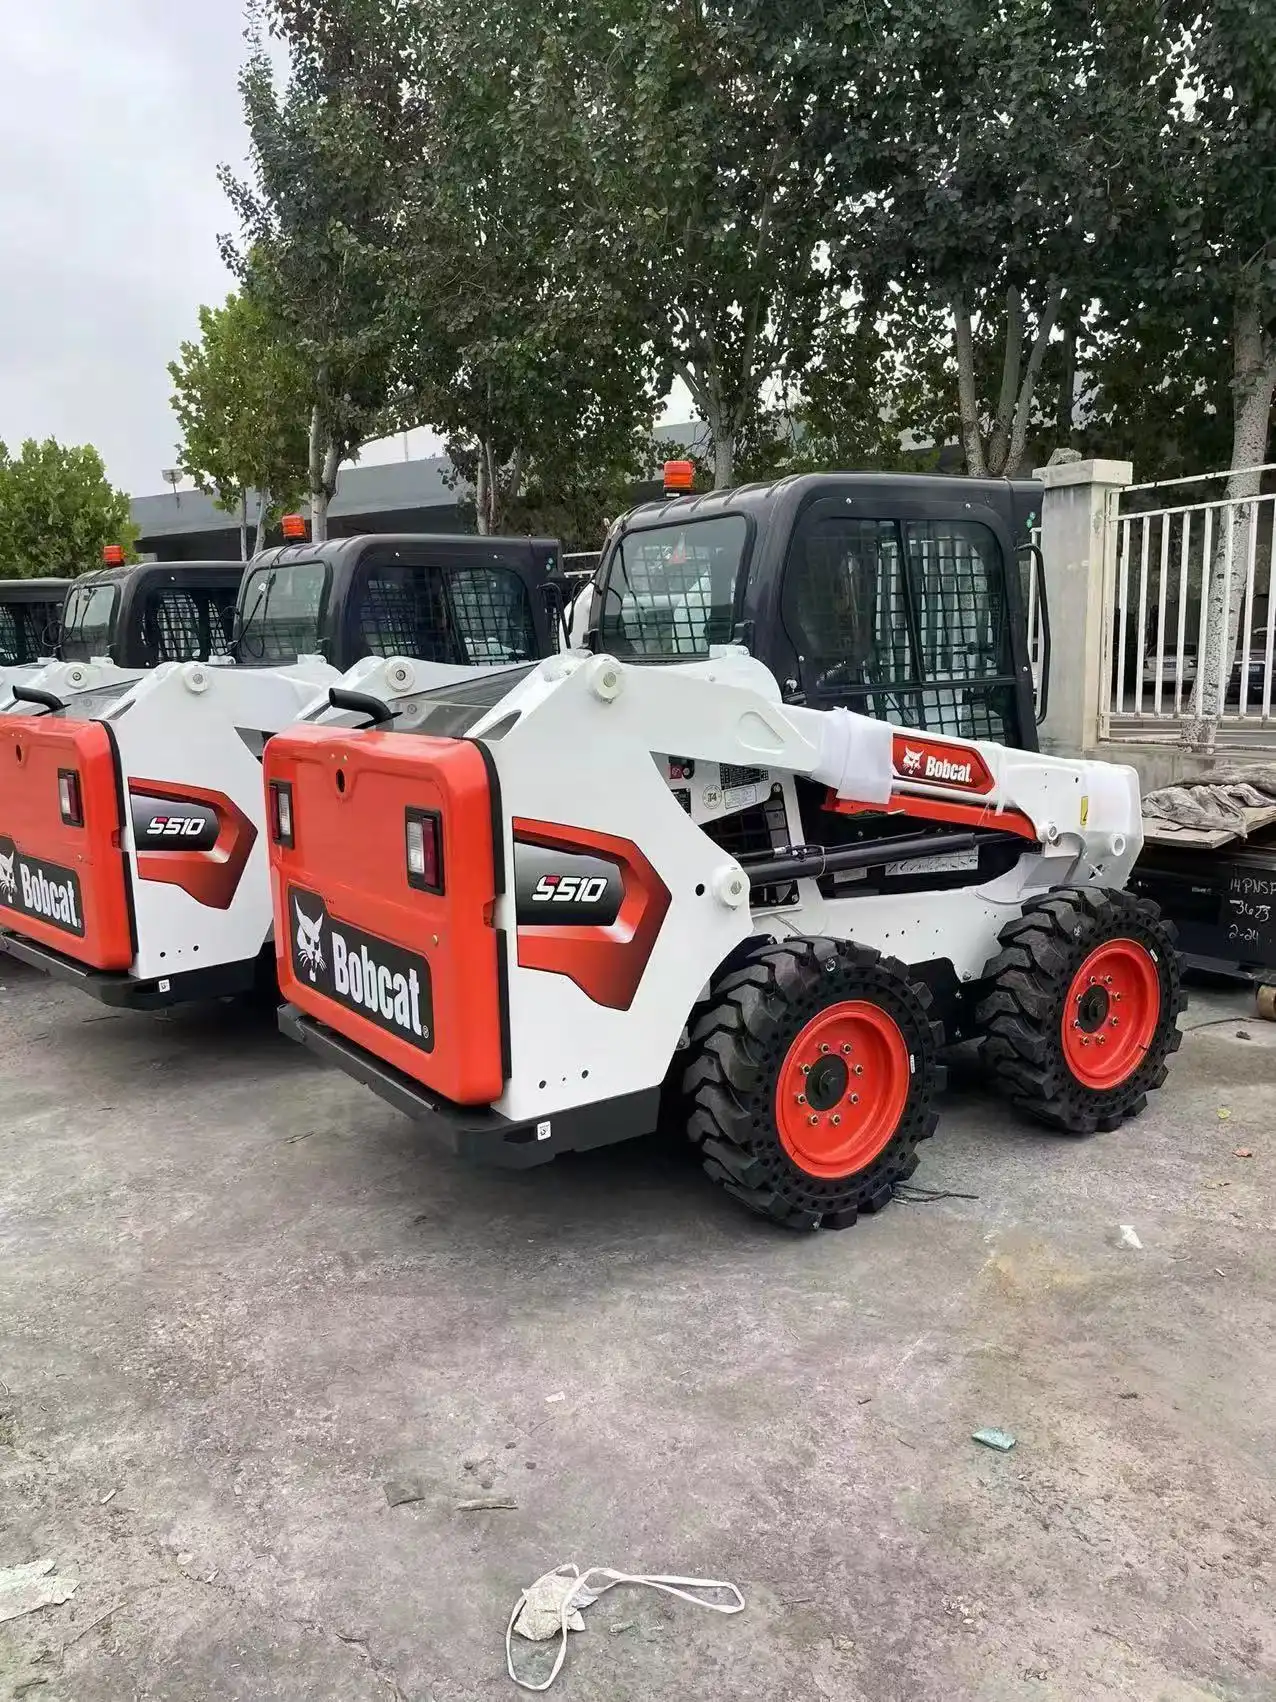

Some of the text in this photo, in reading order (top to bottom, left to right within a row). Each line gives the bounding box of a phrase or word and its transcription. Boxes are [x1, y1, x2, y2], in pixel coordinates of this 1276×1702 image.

[925, 755, 972, 783] Bobcat
[146, 816, 206, 836] S510
[19, 862, 78, 928] Bobcat
[531, 875, 608, 903] S510
[331, 931, 422, 1036] Bobcat
